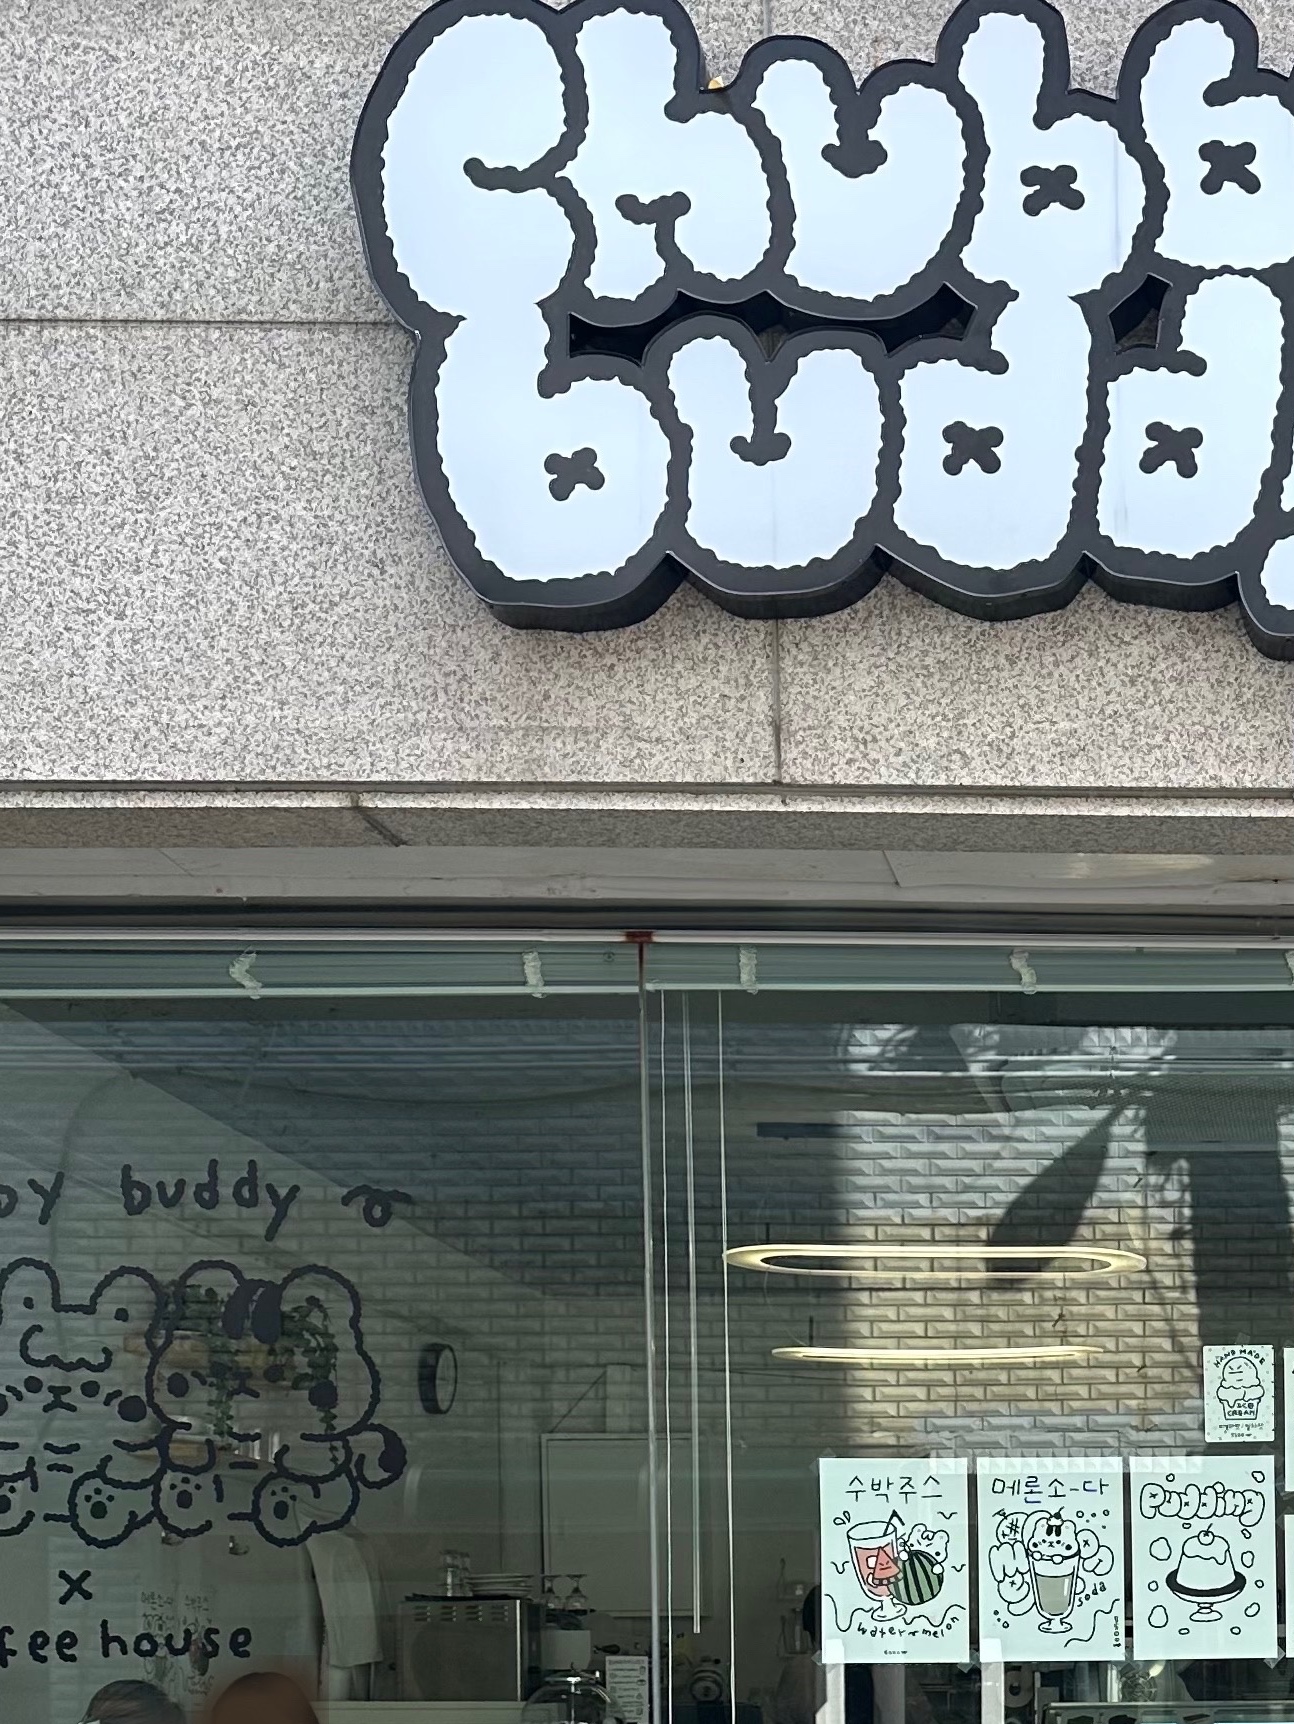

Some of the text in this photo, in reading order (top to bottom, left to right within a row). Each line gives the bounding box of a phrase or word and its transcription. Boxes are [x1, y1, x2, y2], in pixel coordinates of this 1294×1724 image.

[121, 1159, 300, 1241] buddy
[845, 1475, 943, 1504] 수박주스
[1077, 1581, 1107, 1608] soda
[100, 1619, 252, 1660] house
